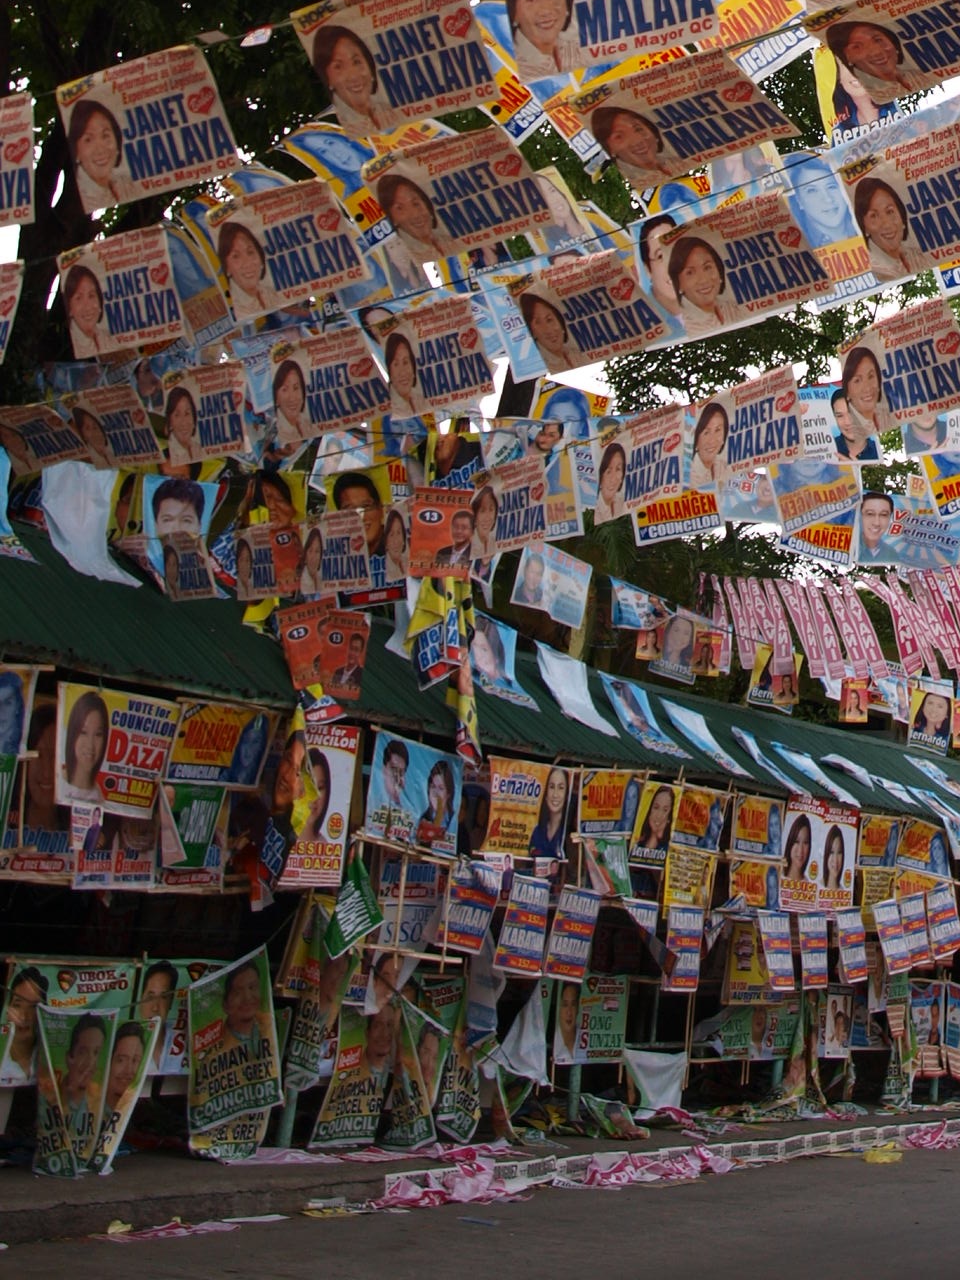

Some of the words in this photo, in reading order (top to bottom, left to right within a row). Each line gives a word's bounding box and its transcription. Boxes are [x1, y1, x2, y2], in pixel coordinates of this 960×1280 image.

[374, 15, 447, 66] JANET
[378, 40, 493, 108] MALAYA
[123, 93, 188, 140] JANET
[123, 116, 236, 181] MALAYA
[882, 338, 938, 379] JANET
[647, 493, 717, 523] MALAÑGEN
[648, 514, 721, 539] COUNCILOR
[889, 522, 960, 547] Belmonte
[788, 536, 849, 564] COUNCILOR
[128, 699, 153, 715] VOTE
[155, 706, 171, 719] for
[111, 711, 176, 738] COUNCILOR
[106, 728, 165, 770] DAZA
[491, 773, 541, 798] Bernardo
